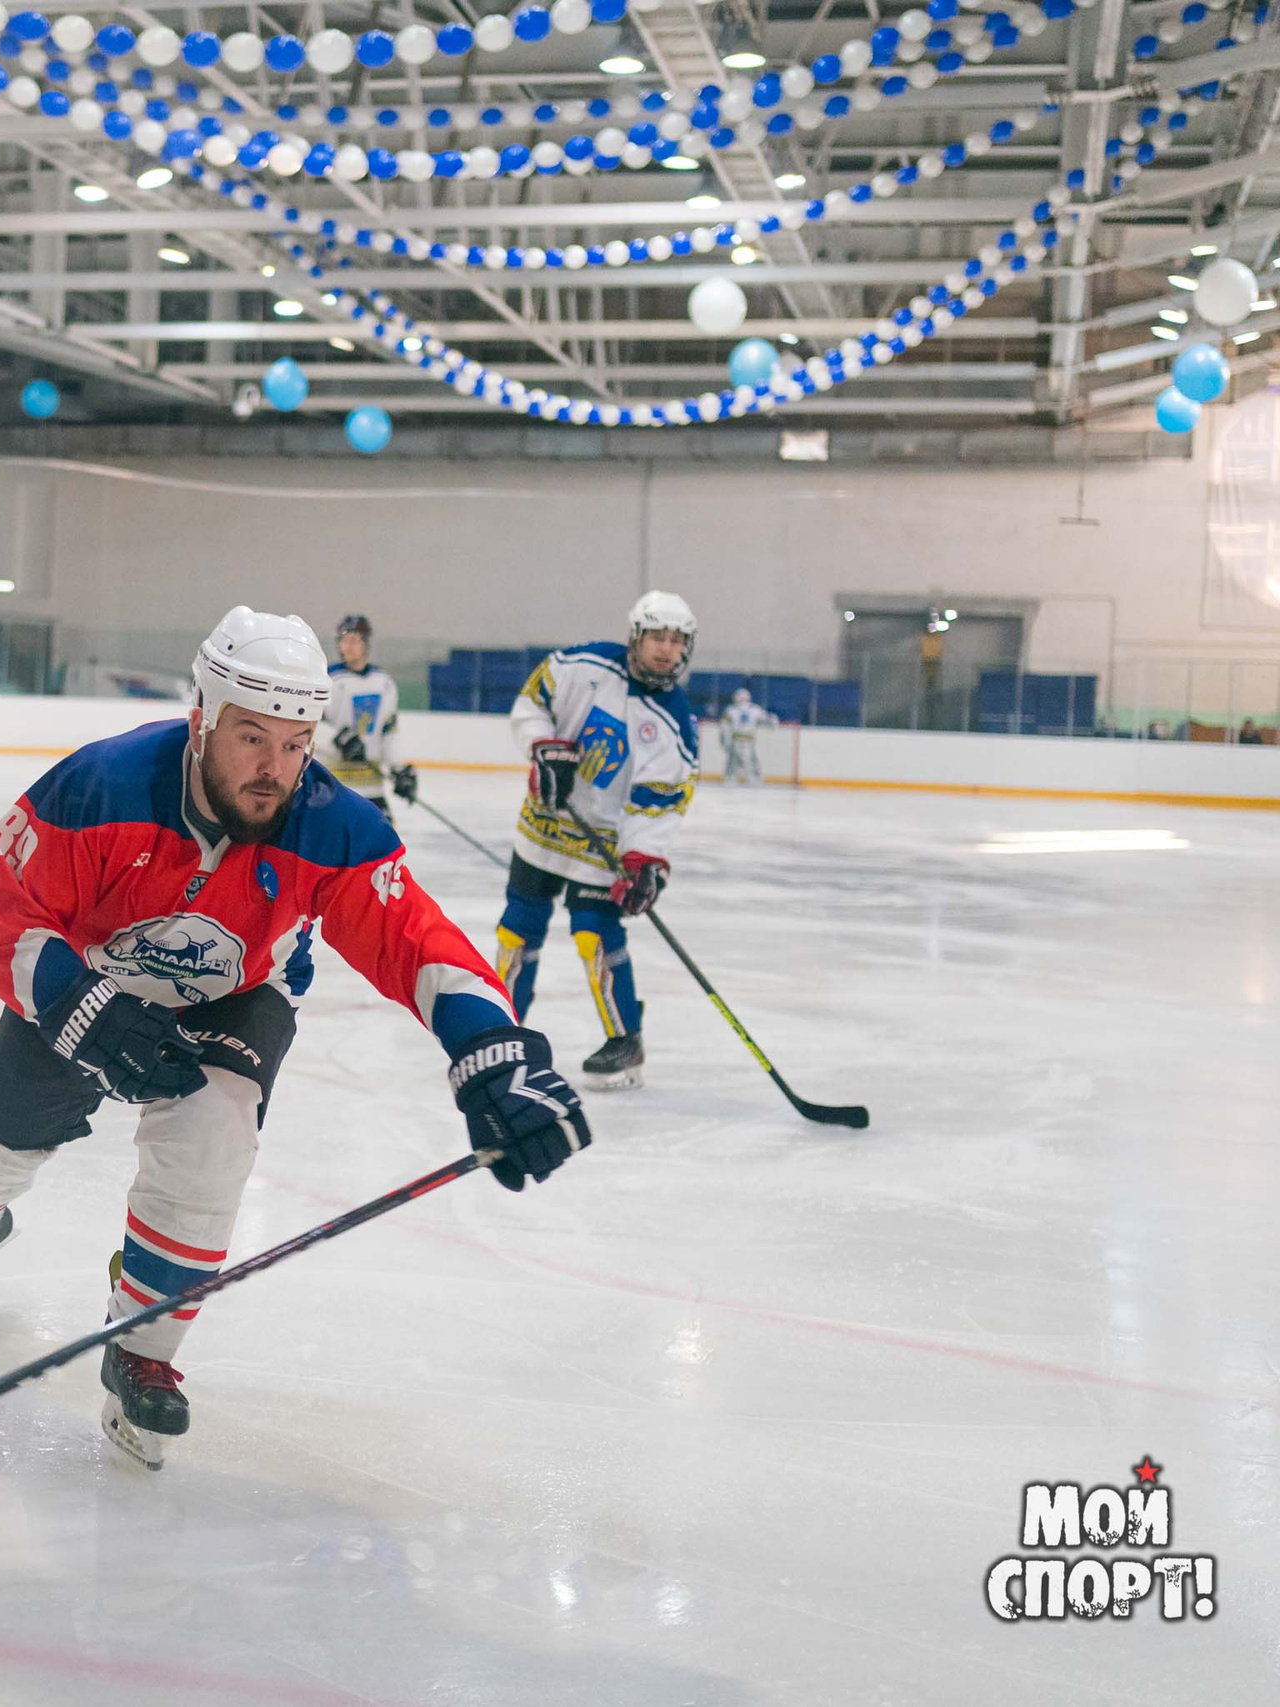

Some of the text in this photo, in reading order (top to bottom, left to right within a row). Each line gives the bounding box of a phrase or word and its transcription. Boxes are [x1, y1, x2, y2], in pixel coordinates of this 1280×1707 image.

[273, 684, 313, 697] BAUER
[53, 977, 122, 1060] WARRIOR
[183, 1029, 262, 1068] AUER
[449, 1040, 527, 1095] RRIOR
